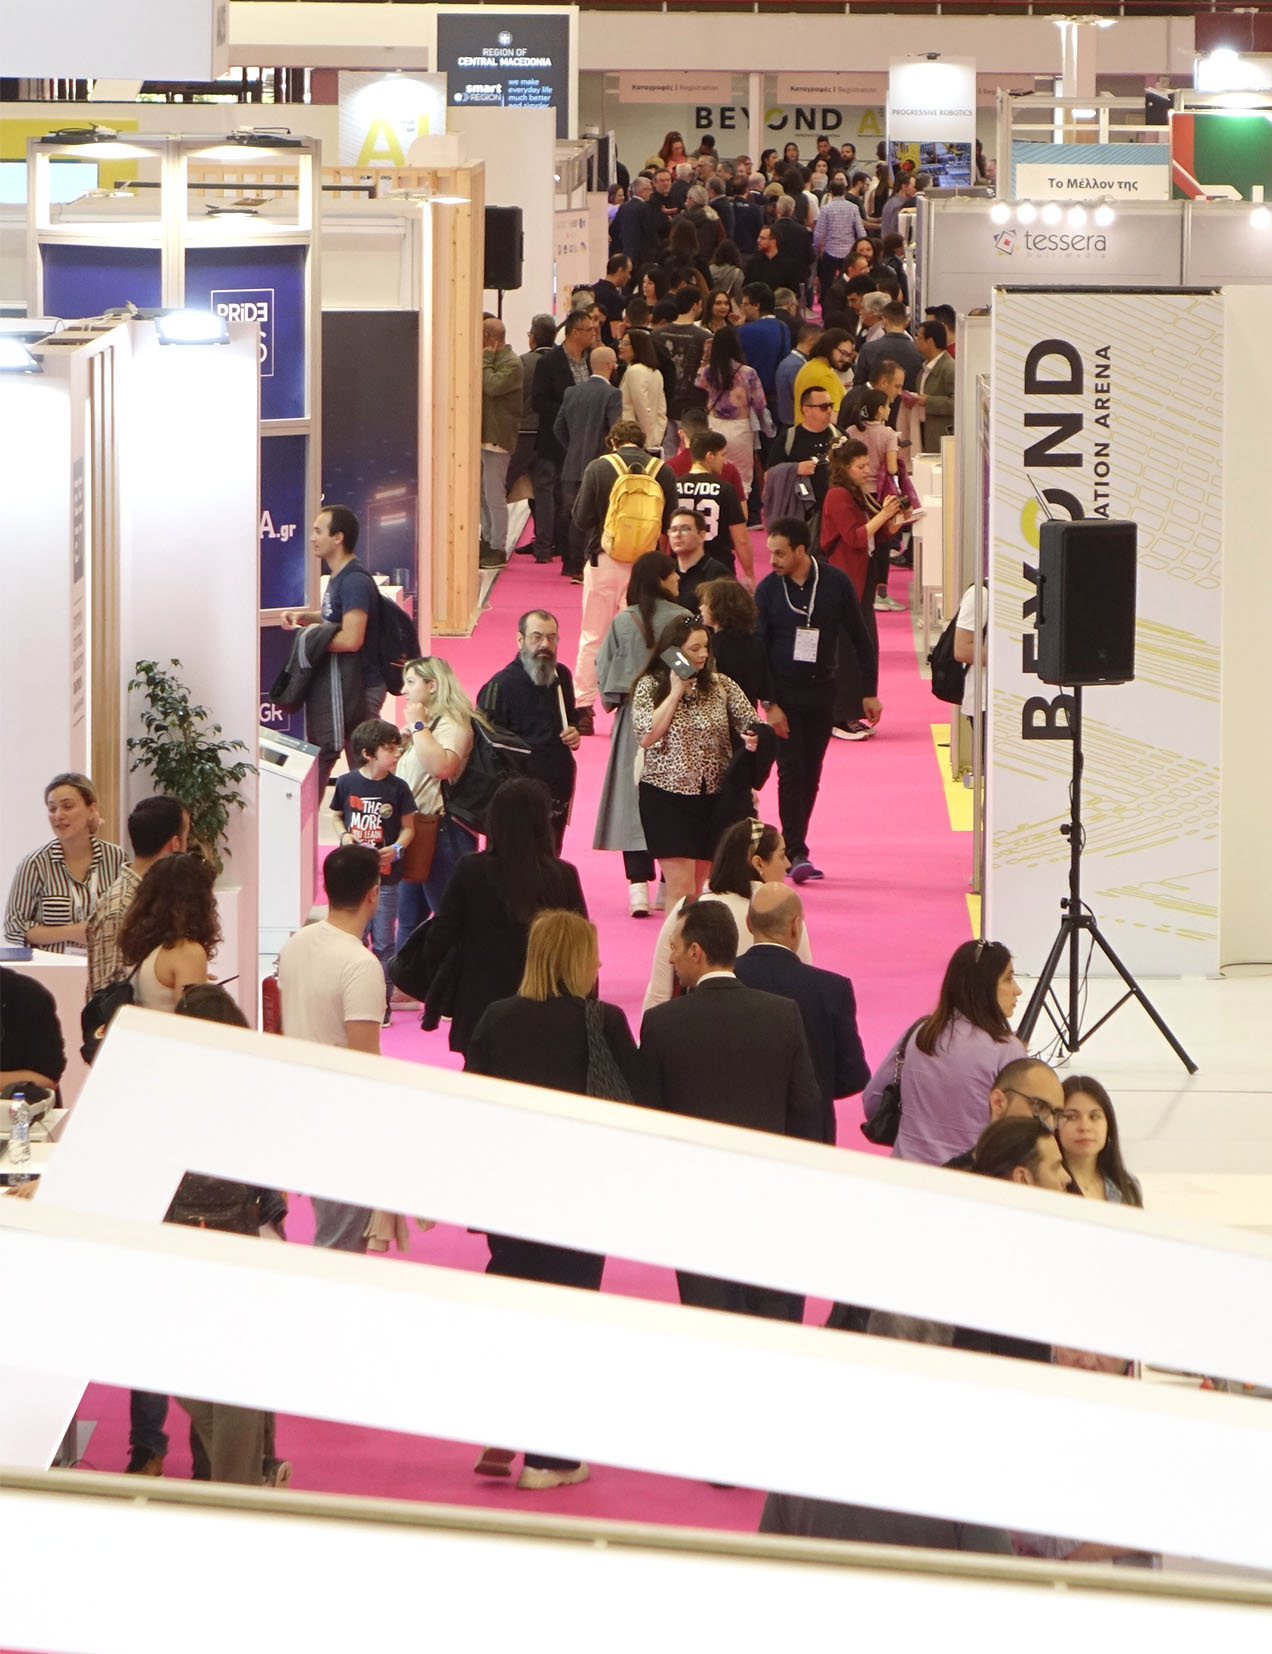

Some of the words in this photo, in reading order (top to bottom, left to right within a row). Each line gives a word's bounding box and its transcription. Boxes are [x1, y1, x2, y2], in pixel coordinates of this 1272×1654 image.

[482, 47, 514, 57] REGION
[515, 47, 528, 57] OF
[457, 56, 498, 67] CENTRAL
[499, 56, 552, 67] MACEDONIA
[465, 82, 502, 94] smart
[520, 78, 540, 86] make
[508, 85, 541, 95] everyday
[541, 85, 553, 94] life
[470, 93, 502, 102] REGION
[508, 94, 528, 102] much
[528, 94, 551, 102] better
[891, 108, 938, 117] PROGRESSIVE
[939, 108, 974, 117] ROBOTICS
[1048, 178, 1063, 189] Το
[1066, 177, 1115, 189] Μέλλον
[1117, 180, 1138, 192] της
[1024, 230, 1107, 251] tessera
[1094, 344, 1111, 429] ARENA
[1094, 442, 1111, 518] ATION
[676, 482, 721, 496] AC/DC
[677, 498, 721, 542] 3
[1020, 338, 1084, 740] BOND
[362, 800, 383, 815] THE
[350, 812, 383, 831] MORE
